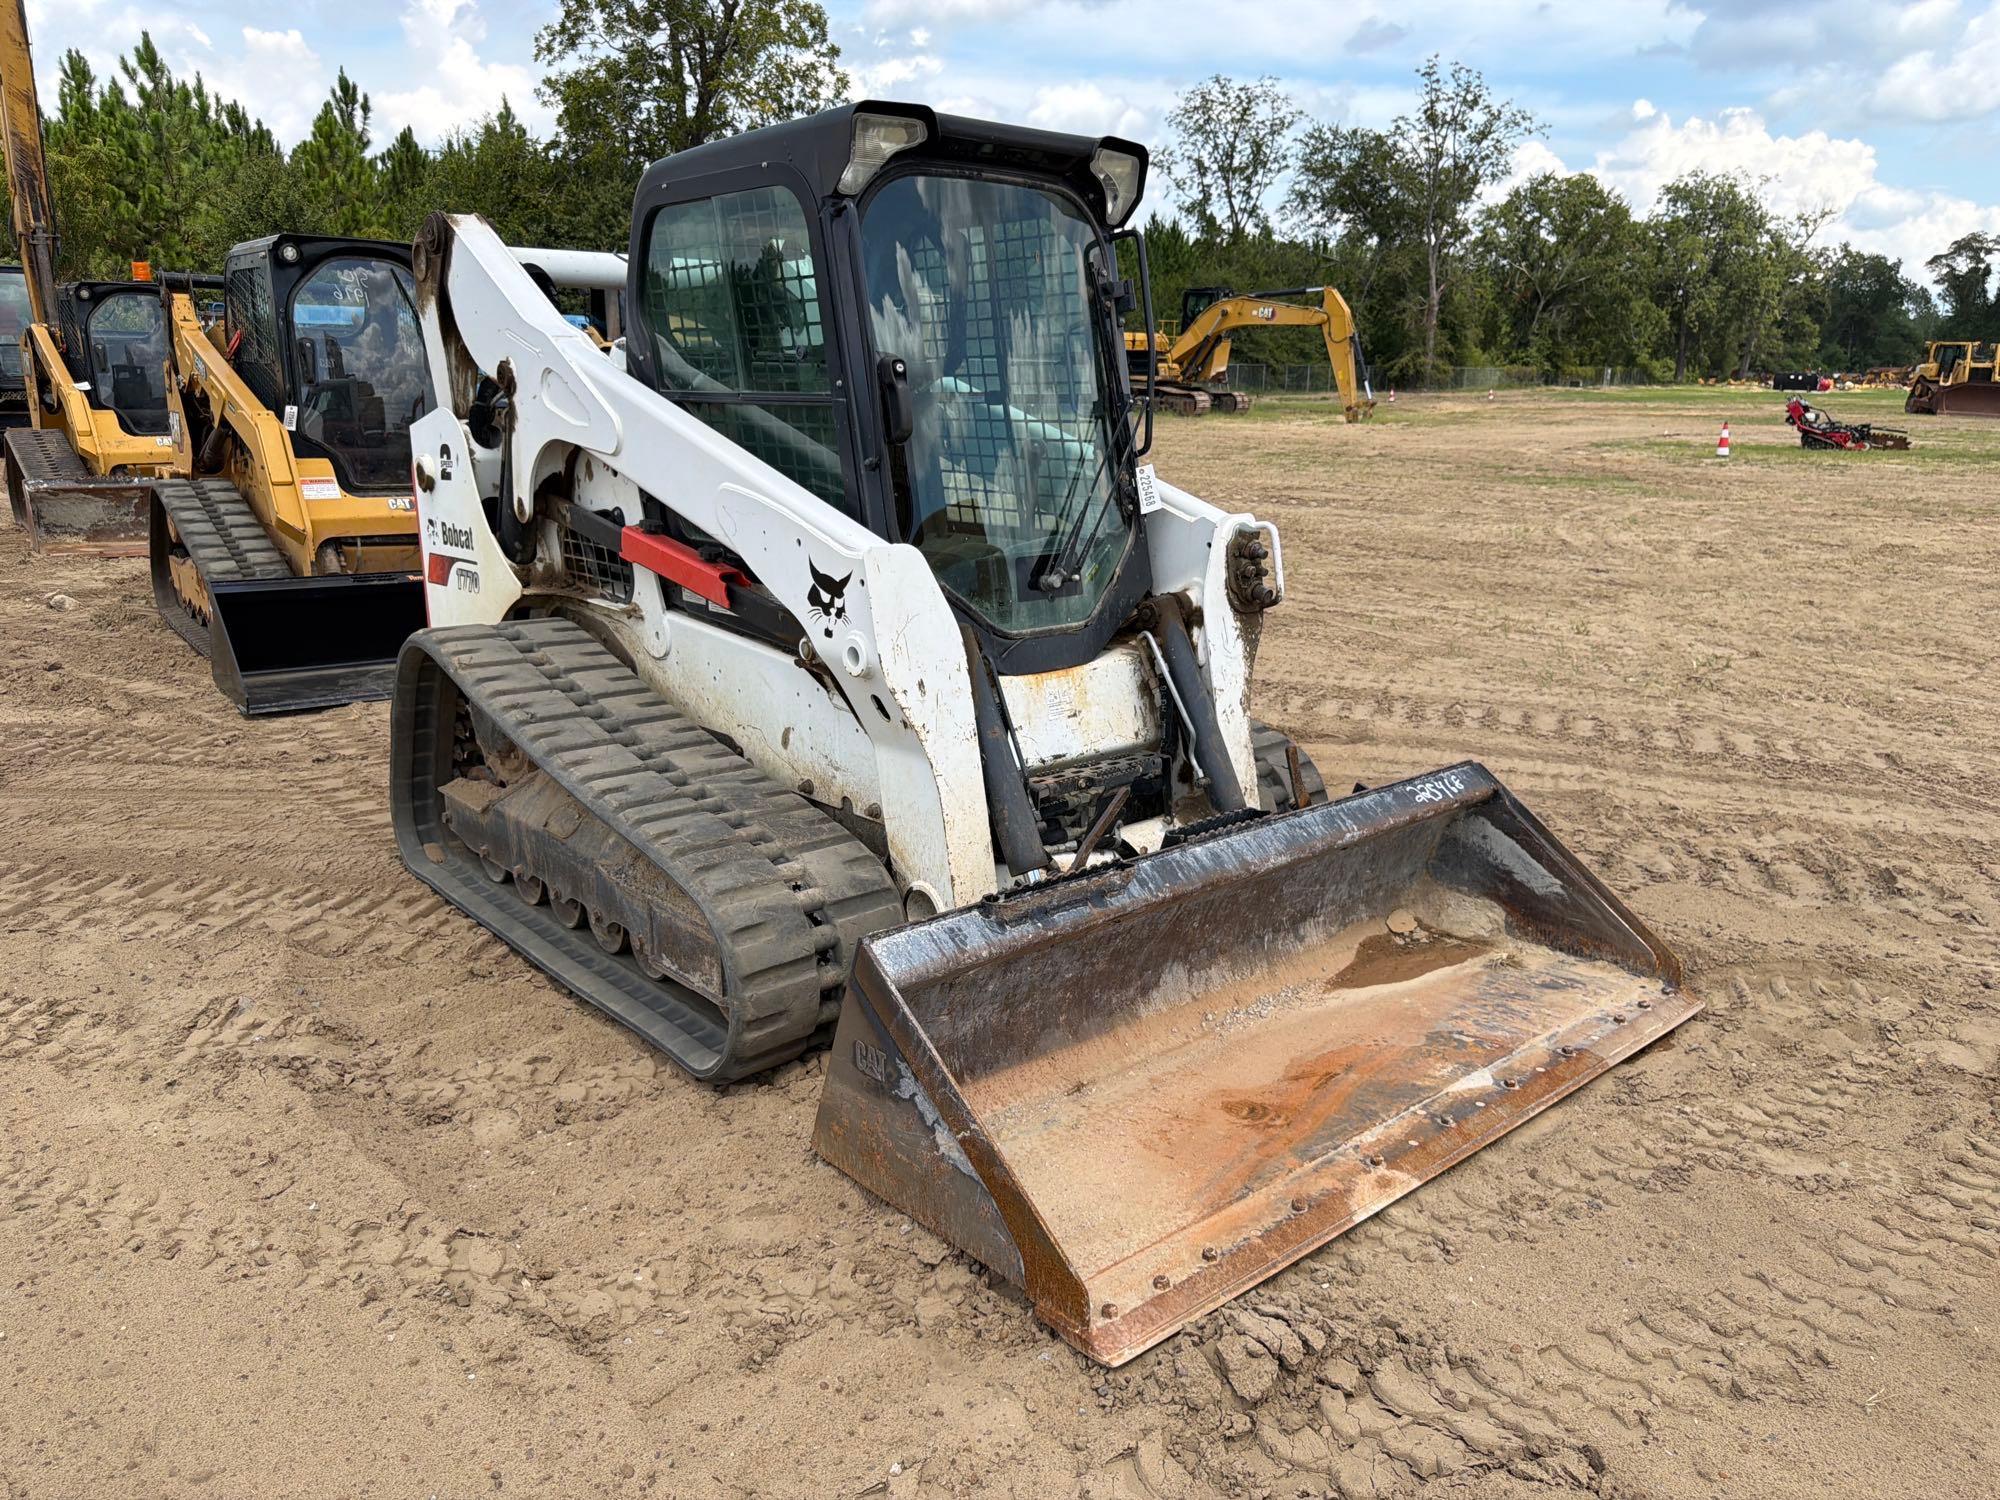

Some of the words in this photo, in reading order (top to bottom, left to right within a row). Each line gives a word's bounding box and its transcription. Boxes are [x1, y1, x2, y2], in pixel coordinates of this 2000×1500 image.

[1258, 306, 1273, 319] CAT
[156, 436, 173, 447] CA
[388, 498, 411, 510] CAT
[1140, 475, 1156, 507] 225468
[441, 521, 474, 551] Bobcat
[456, 568, 480, 594] T770
[855, 1040, 887, 1082] CAT
